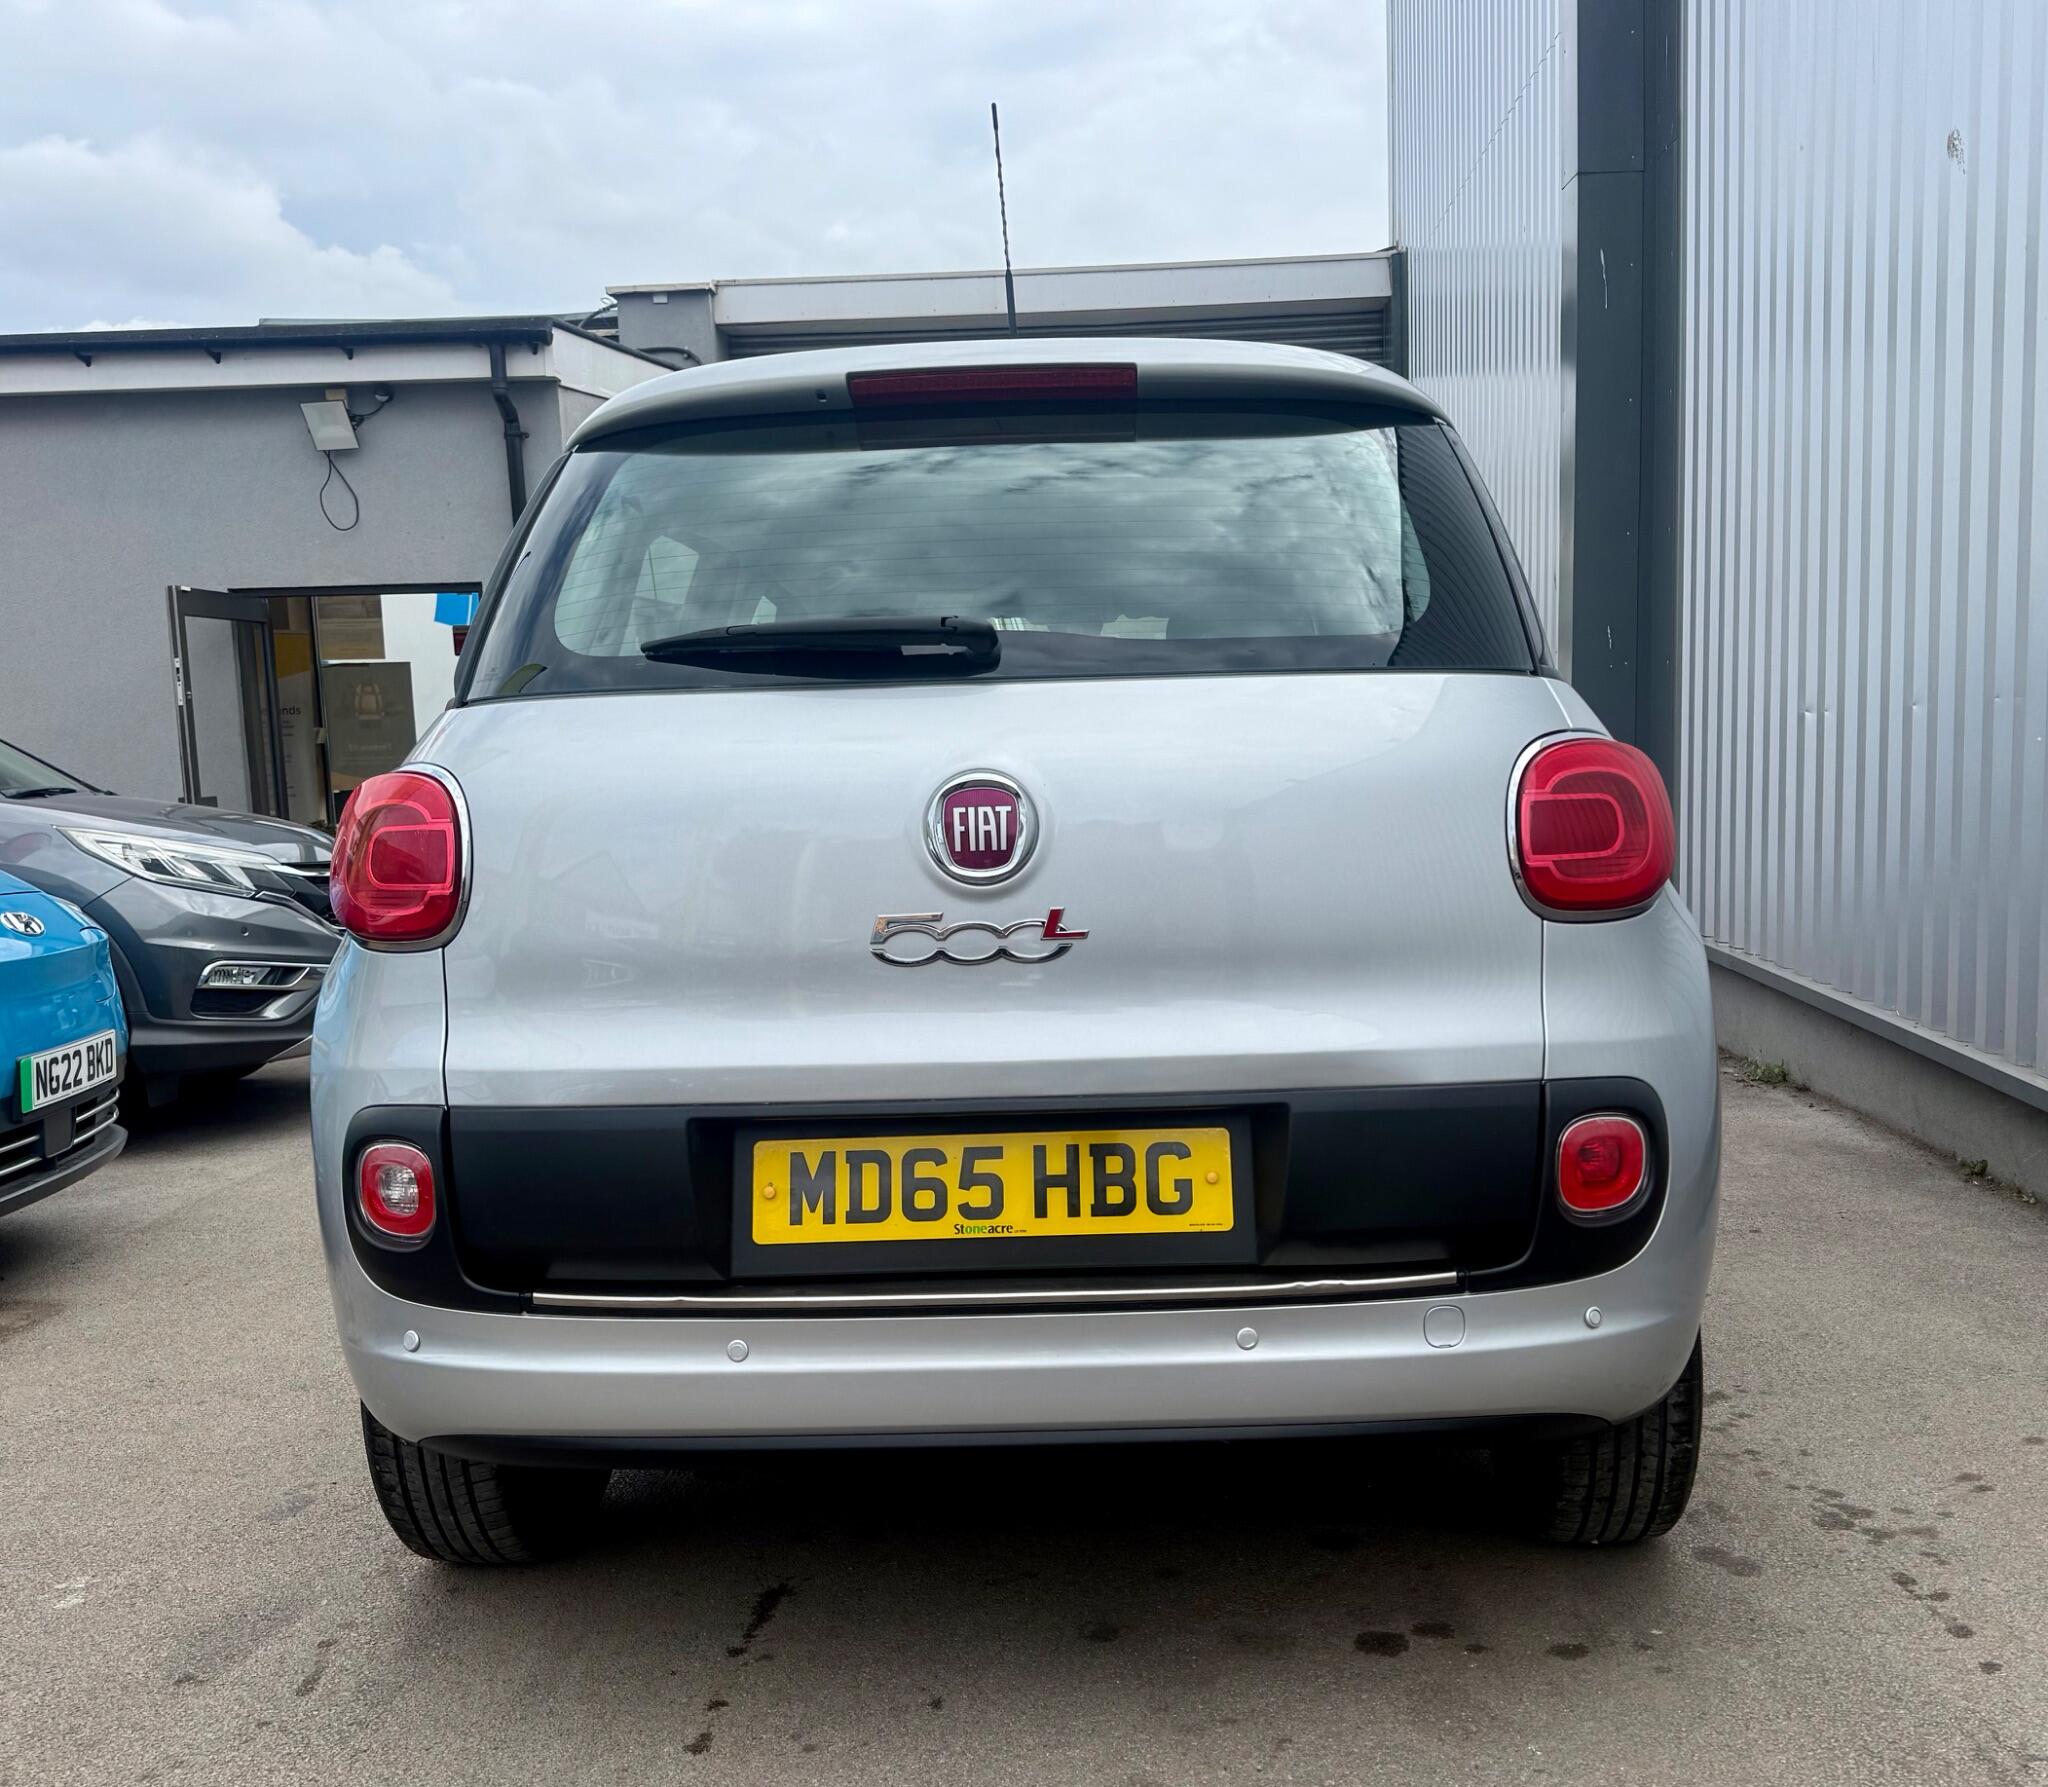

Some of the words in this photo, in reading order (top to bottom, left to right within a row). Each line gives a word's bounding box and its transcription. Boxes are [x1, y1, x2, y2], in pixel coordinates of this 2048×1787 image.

[280, 705, 302, 715] nds
[952, 805, 1012, 852] FIAT
[869, 906, 1090, 968] 500L
[35, 1049, 83, 1101] NG22
[86, 1038, 114, 1082] BKD
[788, 1146, 1005, 1226] MD65
[1032, 1141, 1194, 1219] HBG
[953, 1223, 1014, 1235] Stoneacre
